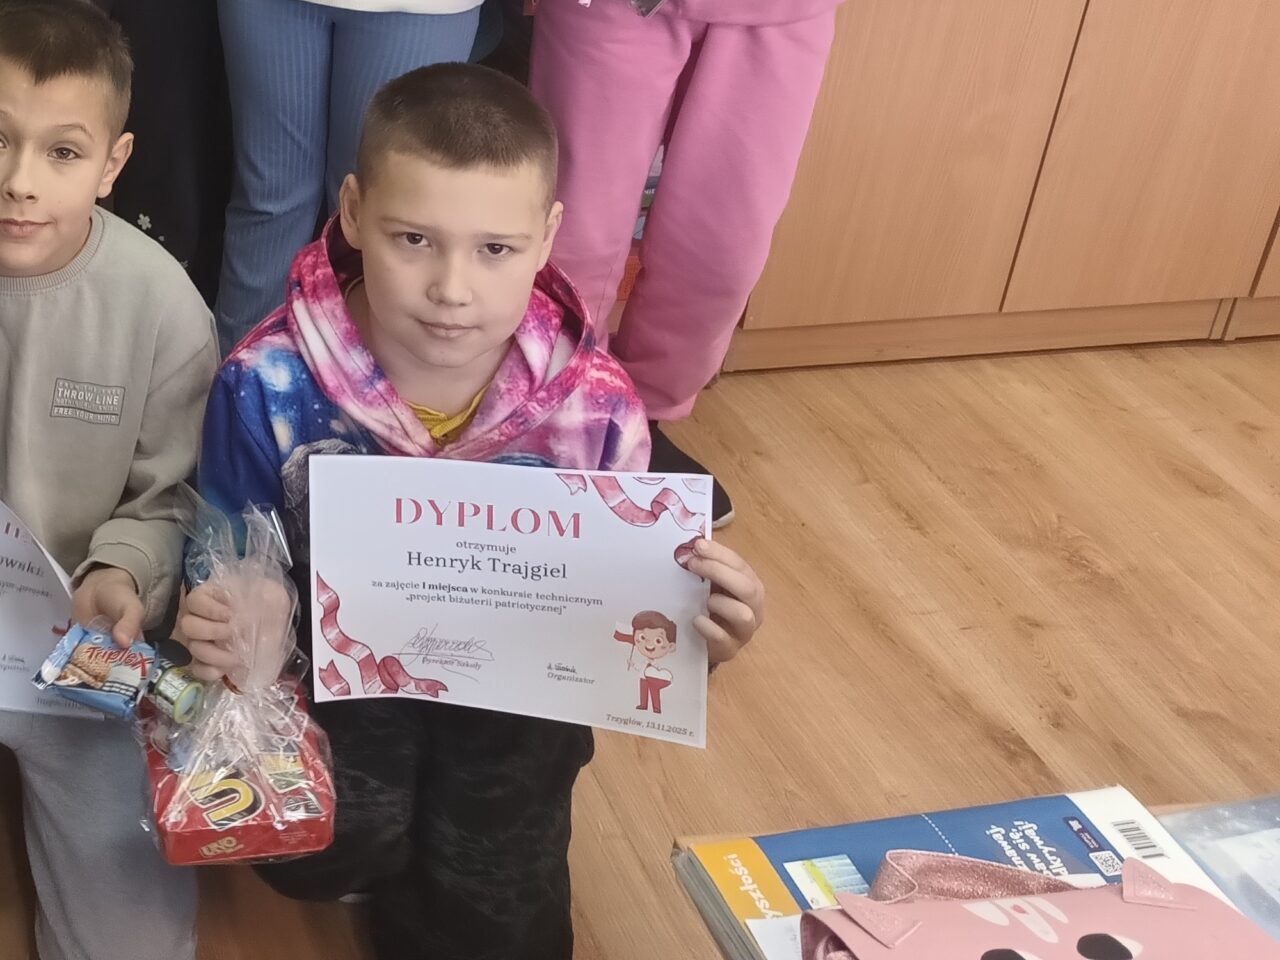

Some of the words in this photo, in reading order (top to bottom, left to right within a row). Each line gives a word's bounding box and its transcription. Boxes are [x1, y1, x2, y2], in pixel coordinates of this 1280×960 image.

[58, 388, 93, 401] THROW
[96, 396, 119, 405] LINE
[394, 497, 581, 539] DYPLOM
[456, 539, 517, 554] otrzymuje
[407, 551, 481, 572] Henryk
[488, 557, 567, 581] Trajgiel
[371, 580, 383, 588] za
[385, 579, 420, 591] zajęcie
[422, 581, 426, 589] I
[428, 582, 468, 594] miejsca
[481, 586, 533, 600] konkursie
[535, 591, 603, 606] technicznym
[448, 595, 492, 607] biżuterii
[547, 672, 595, 685] Organizator
[646, 721, 687, 736] 13.11.2025
[1014, 821, 1069, 875] dkrywaj!
